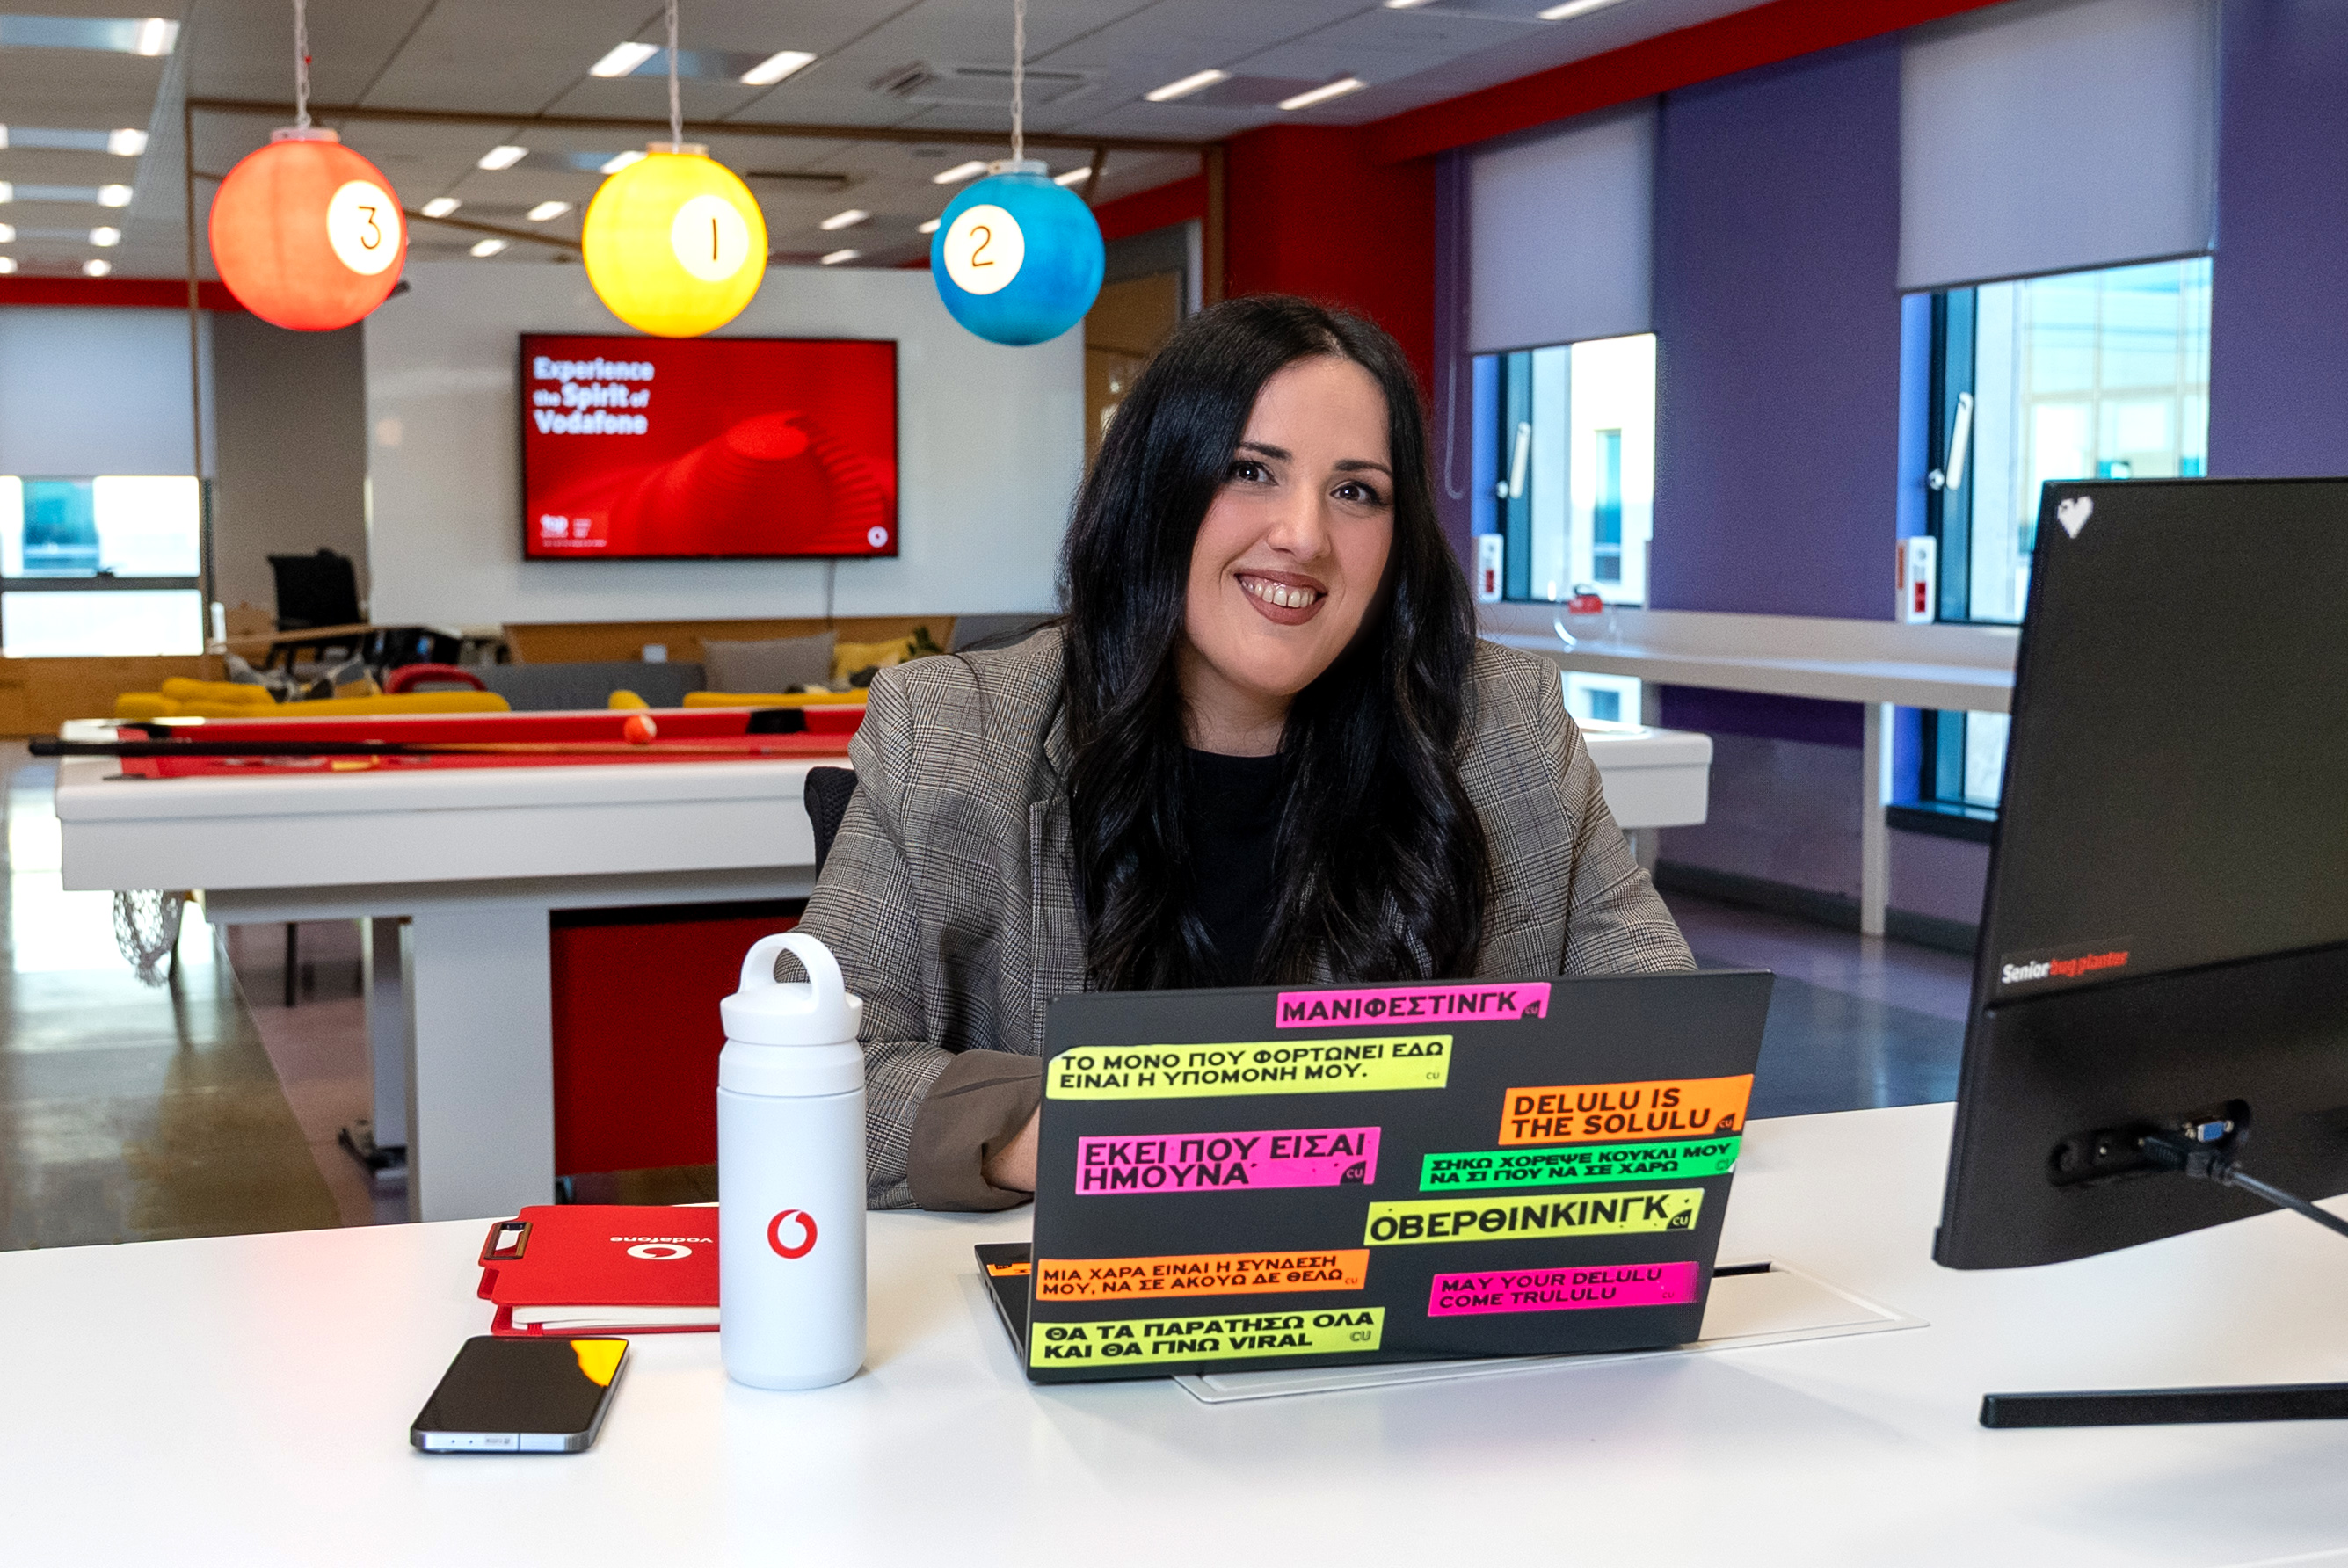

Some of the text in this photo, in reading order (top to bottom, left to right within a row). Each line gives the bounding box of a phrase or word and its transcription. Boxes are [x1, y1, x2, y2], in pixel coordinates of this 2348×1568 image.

[358, 205, 382, 250] 3
[711, 217, 718, 261] 1
[969, 225, 995, 268] 2
[533, 355, 655, 384] Experience
[533, 381, 651, 412] the Spirit of
[533, 409, 649, 435] Vodafone
[2001, 960, 2051, 984] Senior
[1283, 991, 1518, 1022] ΜΑΝΙΦΕΣΤΙΝΓΚ
[1062, 1042, 1444, 1071] ΤΟ ΜΟΝΟ ΠΟΥ ΦΟΡΤΩΝΕΙ ΕΔΩ
[1060, 1063, 1368, 1089] ΕΙΝΑΙ Η ΥΠΟΜΟΝΗ ΜΟΥ.
[1514, 1087, 1681, 1116] DELULU IS
[1511, 1107, 1711, 1139] THE SOLULU
[1085, 1133, 1365, 1166] ΕΚΕΙ ΠΟΥ ΕΙΣΑΙ
[1430, 1143, 1732, 1172] ΣΗΚΩ ΧΟΡΕΨΕ ΚΟΥΚΛΙ ΜΟΥ
[1083, 1162, 1249, 1190] ΗΜΟΥΝΑ
[1429, 1172, 1461, 1185] ΝΑ
[1493, 1167, 1544, 1181] ΠΟΥ
[1548, 1165, 1579, 1179] ΝΑ
[1583, 1163, 1613, 1177] ΣΕ
[1617, 1160, 1679, 1175] ΧΑΡΩ
[1370, 1194, 1669, 1242] ΟΒΕΡΘΙΝΚΙΝΓΚ
[1043, 1255, 1337, 1281] ΜΙΑ ΧΑΡΑ ΕΙΝΑΙ Η ΣΥΝΔΕΣΗ
[1102, 1281, 1132, 1293] ΝΑ
[1138, 1278, 1165, 1291] ΣΕ
[1170, 1274, 1247, 1289] ΑΚΟΥΩ
[1252, 1272, 1281, 1285] ΔΕ
[1286, 1268, 1343, 1283] ΘΕΛΩ
[1441, 1268, 1662, 1293] MAY YOUR DELULU
[1439, 1287, 1617, 1309] COME TRULULU
[1045, 1311, 1374, 1341] ΘΑ ΤΑ ΠΑΡΑΤΗΣΩ ΟΛΑ
[1044, 1345, 1092, 1359] ΚΑΙ
[1101, 1342, 1143, 1357] ΘΑ
[1228, 1332, 1313, 1351] VIRAL
